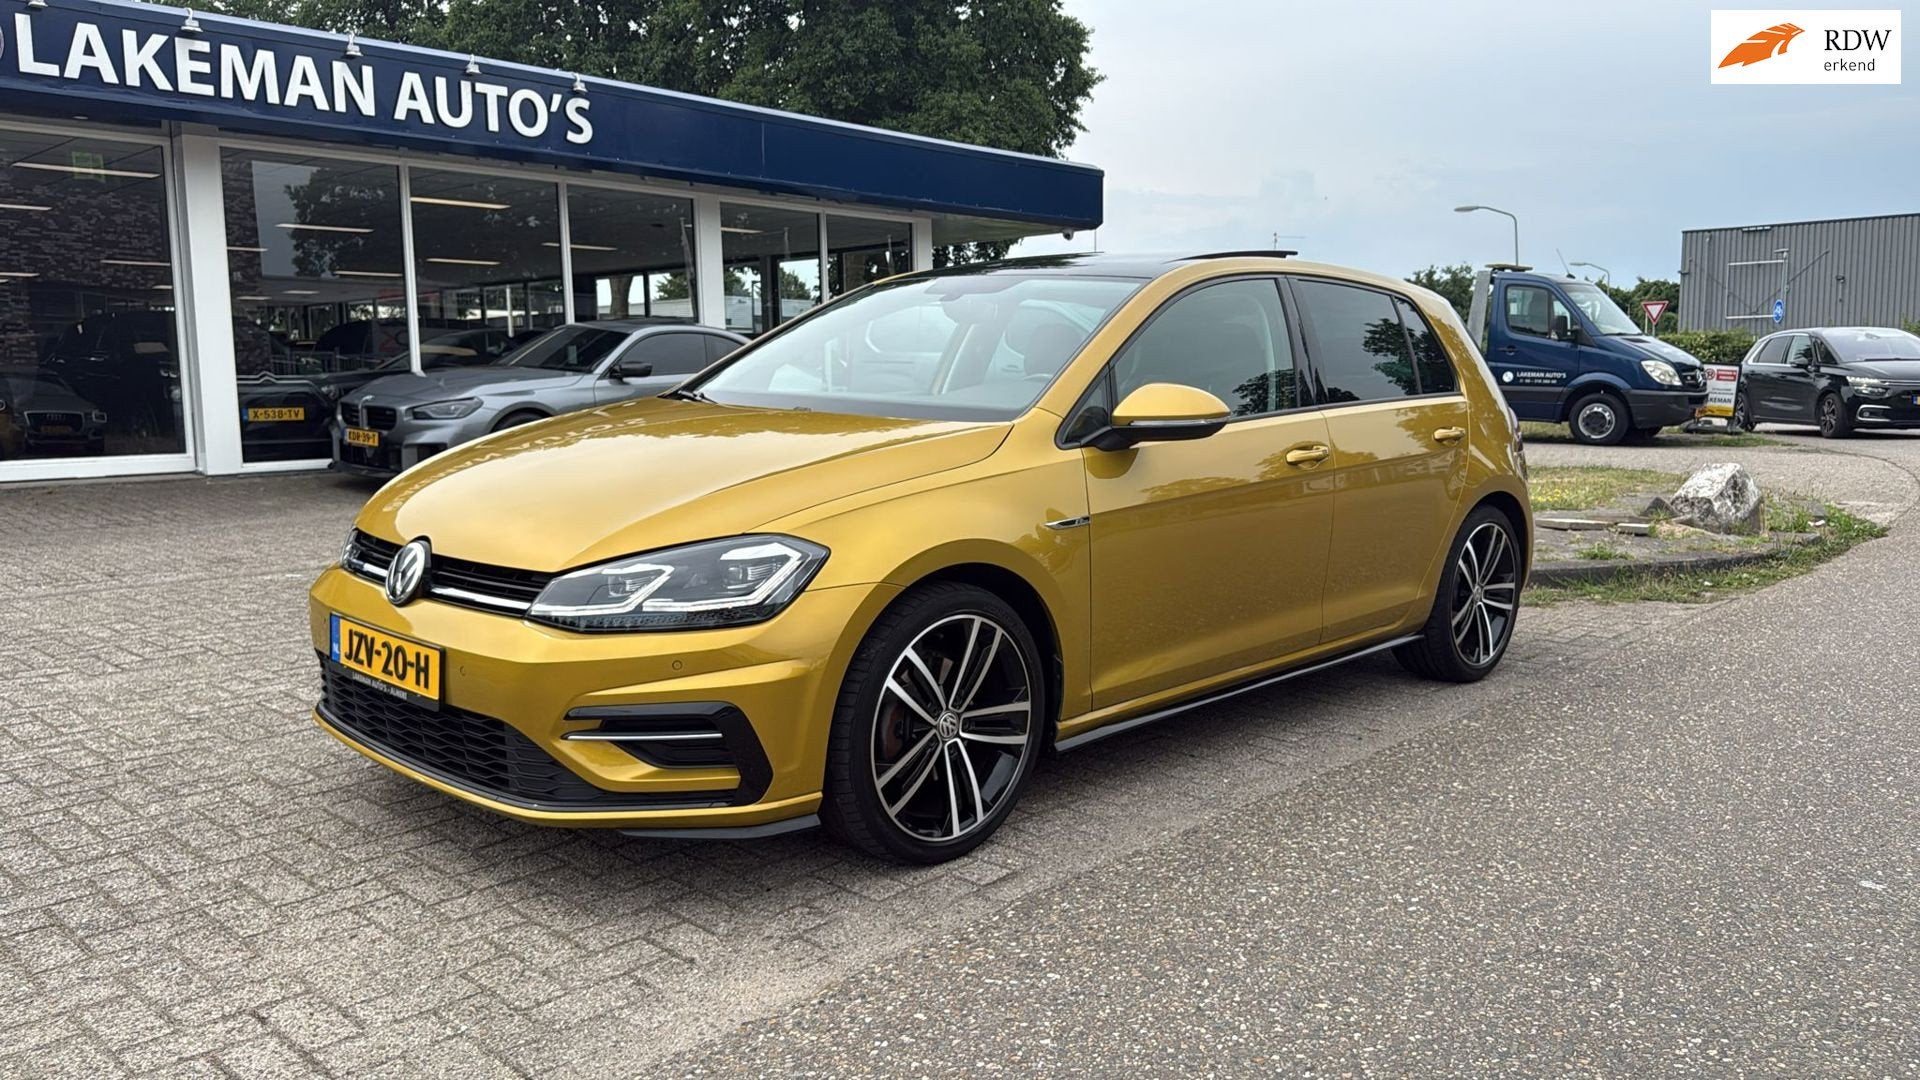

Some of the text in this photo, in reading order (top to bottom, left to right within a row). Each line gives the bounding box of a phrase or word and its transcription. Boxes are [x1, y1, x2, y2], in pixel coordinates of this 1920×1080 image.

[14, 12, 594, 144] LAKEMAN AUTO'S
[253, 408, 300, 419] X-538-TV
[344, 628, 430, 690] JZV-20-H
